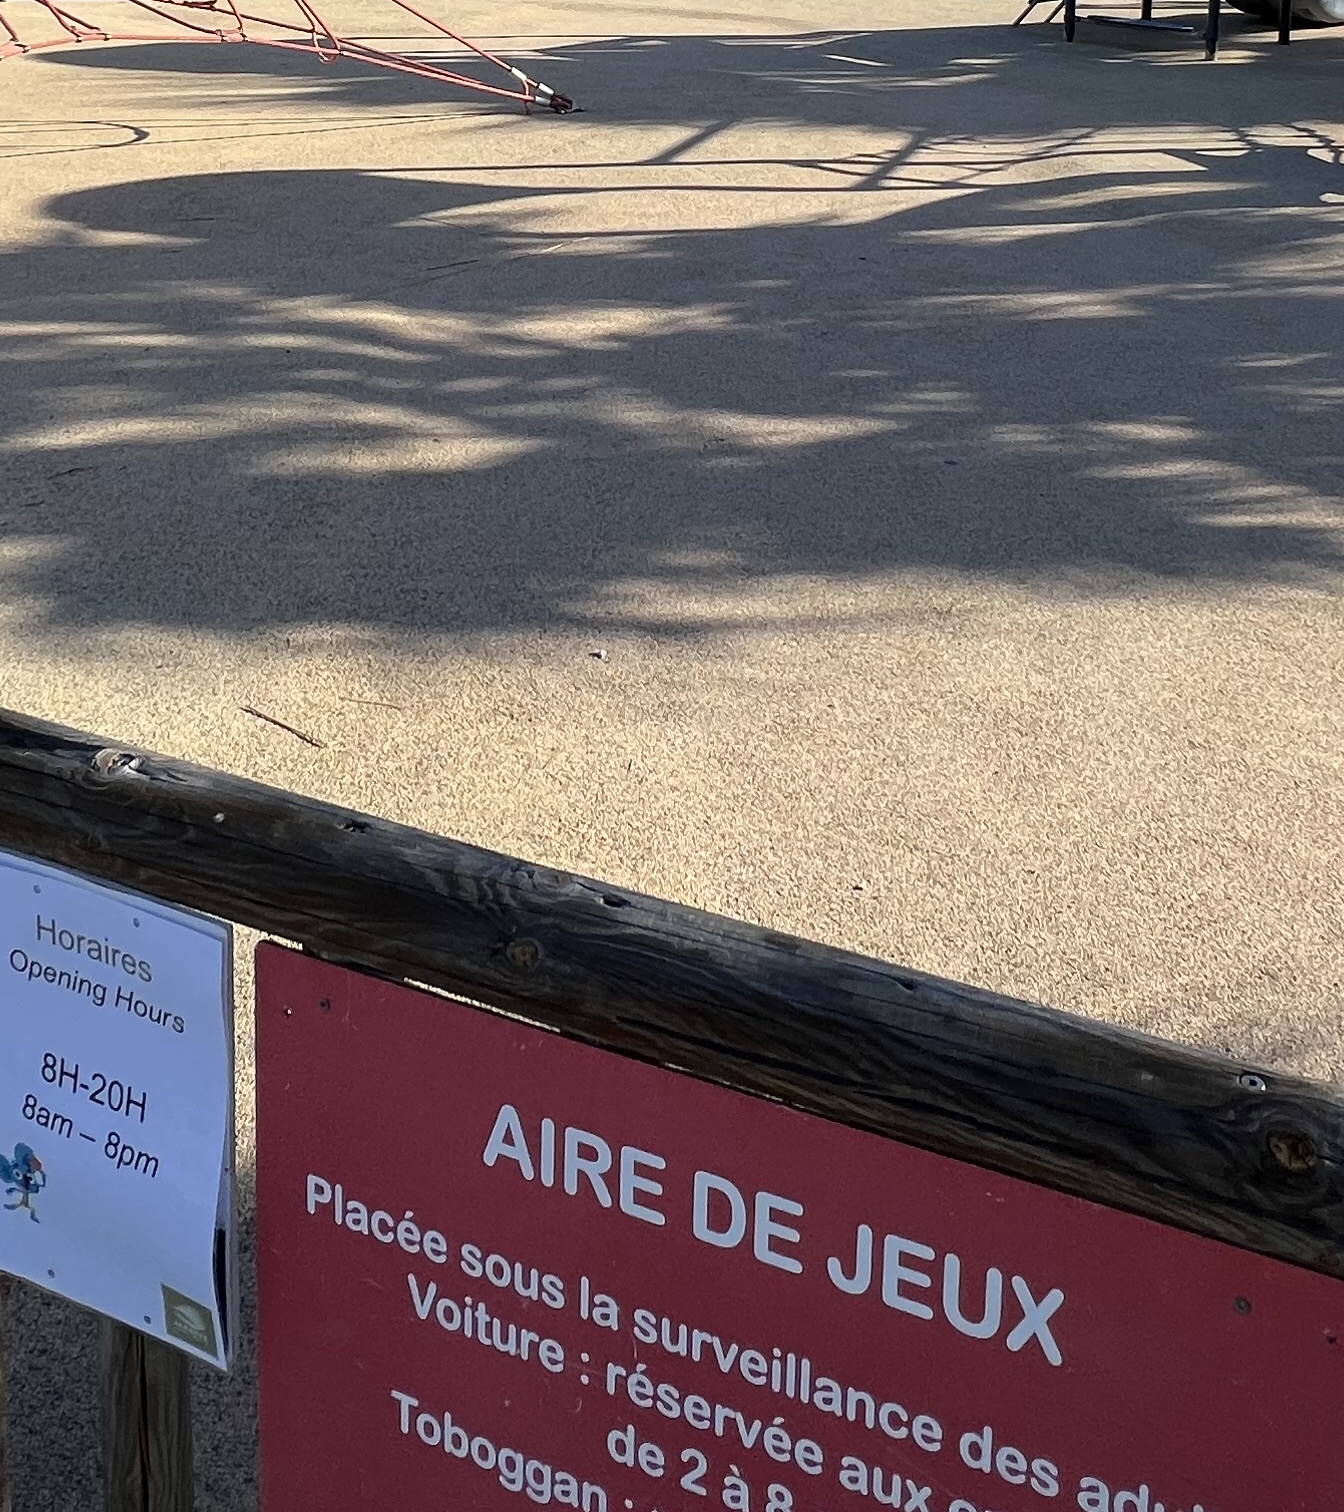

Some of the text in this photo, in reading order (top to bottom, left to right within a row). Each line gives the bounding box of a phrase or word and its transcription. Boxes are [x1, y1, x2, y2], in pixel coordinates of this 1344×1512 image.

[9, 949, 186, 1034] Opening Hours
[36, 913, 153, 983] Horaires
[41, 1052, 147, 1123] 8H-20H
[22, 1094, 73, 1138] 8am
[104, 1132, 159, 1178] 8pm
[482, 1104, 1065, 1366] AIRE DE JEUX
[306, 1173, 448, 1264] Placée
[460, 1243, 566, 1309] sous
[579, 1275, 619, 1331] la
[633, 1308, 943, 1452] surveillance
[959, 1425, 1059, 1497] des
[408, 1273, 565, 1373] Voiture
[606, 1361, 824, 1476] réservée
[839, 1454, 933, 1512] aux
[390, 1390, 608, 1512] Toboggan
[607, 1424, 665, 1478] de
[679, 1448, 708, 1497] 2
[721, 1464, 750, 1512] à
